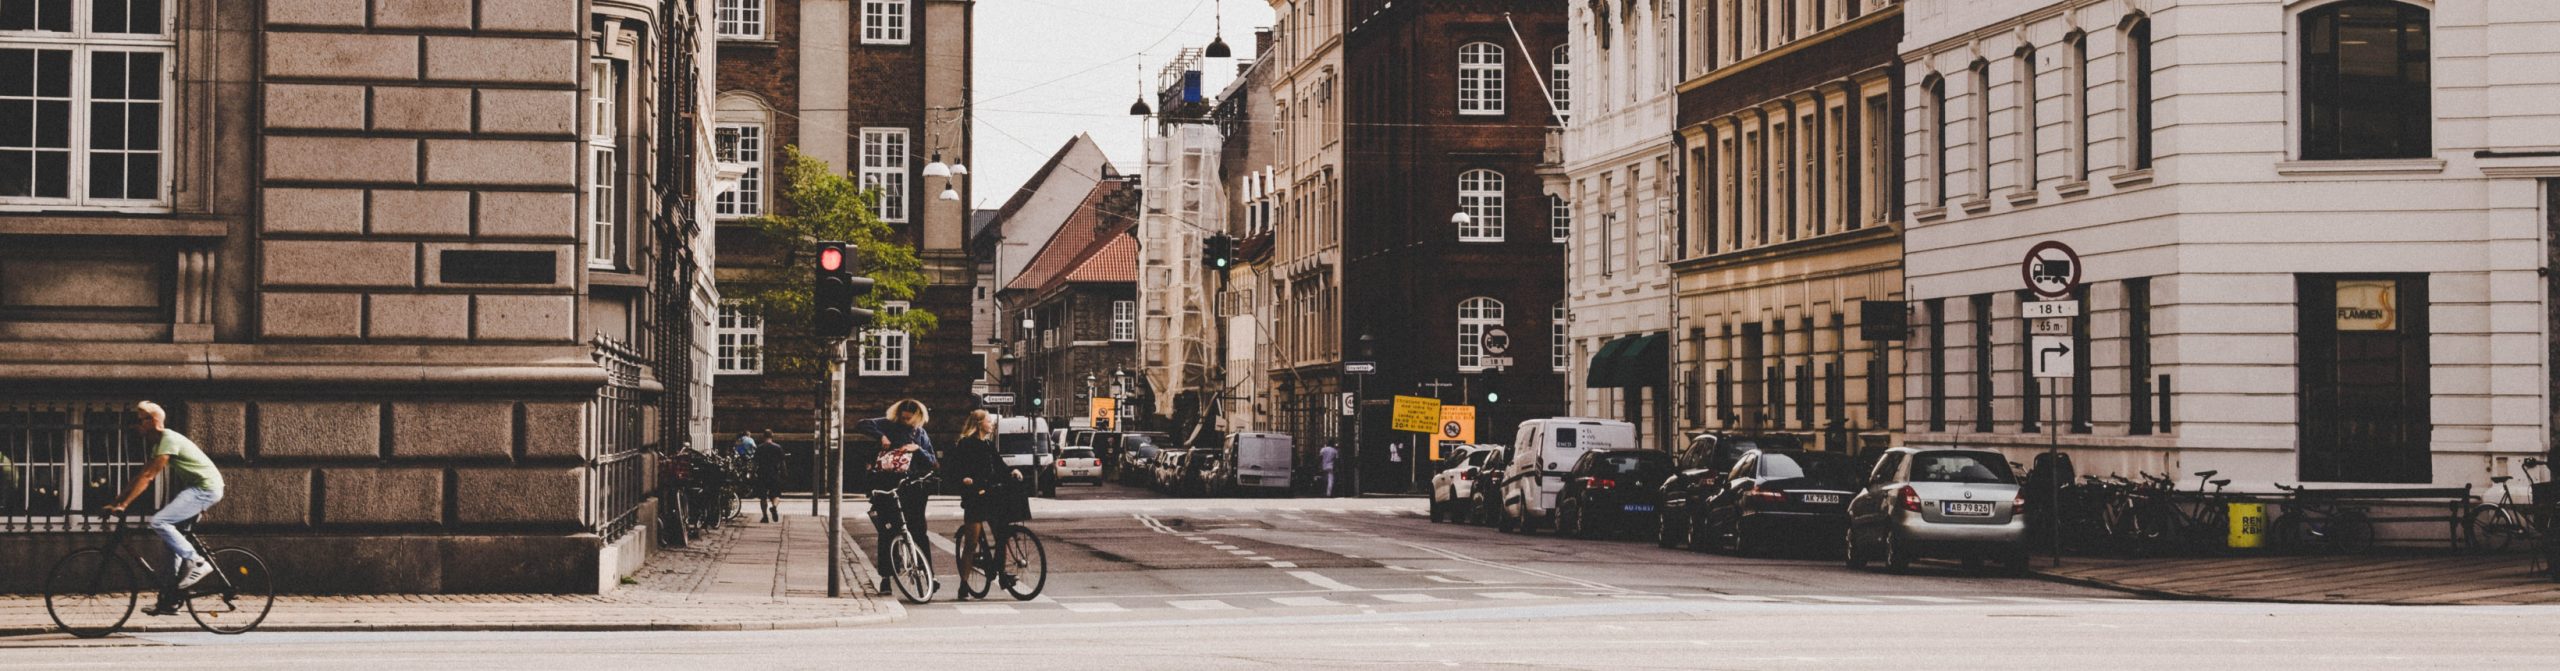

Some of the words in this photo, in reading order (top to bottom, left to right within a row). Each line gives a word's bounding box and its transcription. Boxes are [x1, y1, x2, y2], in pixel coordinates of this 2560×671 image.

[2039, 304, 2052, 314] 18
[2058, 304, 2063, 314] t
[2338, 309, 2383, 319] FLAMMEN
[2040, 321, 2051, 331] 65
[2053, 323, 2060, 331] m
